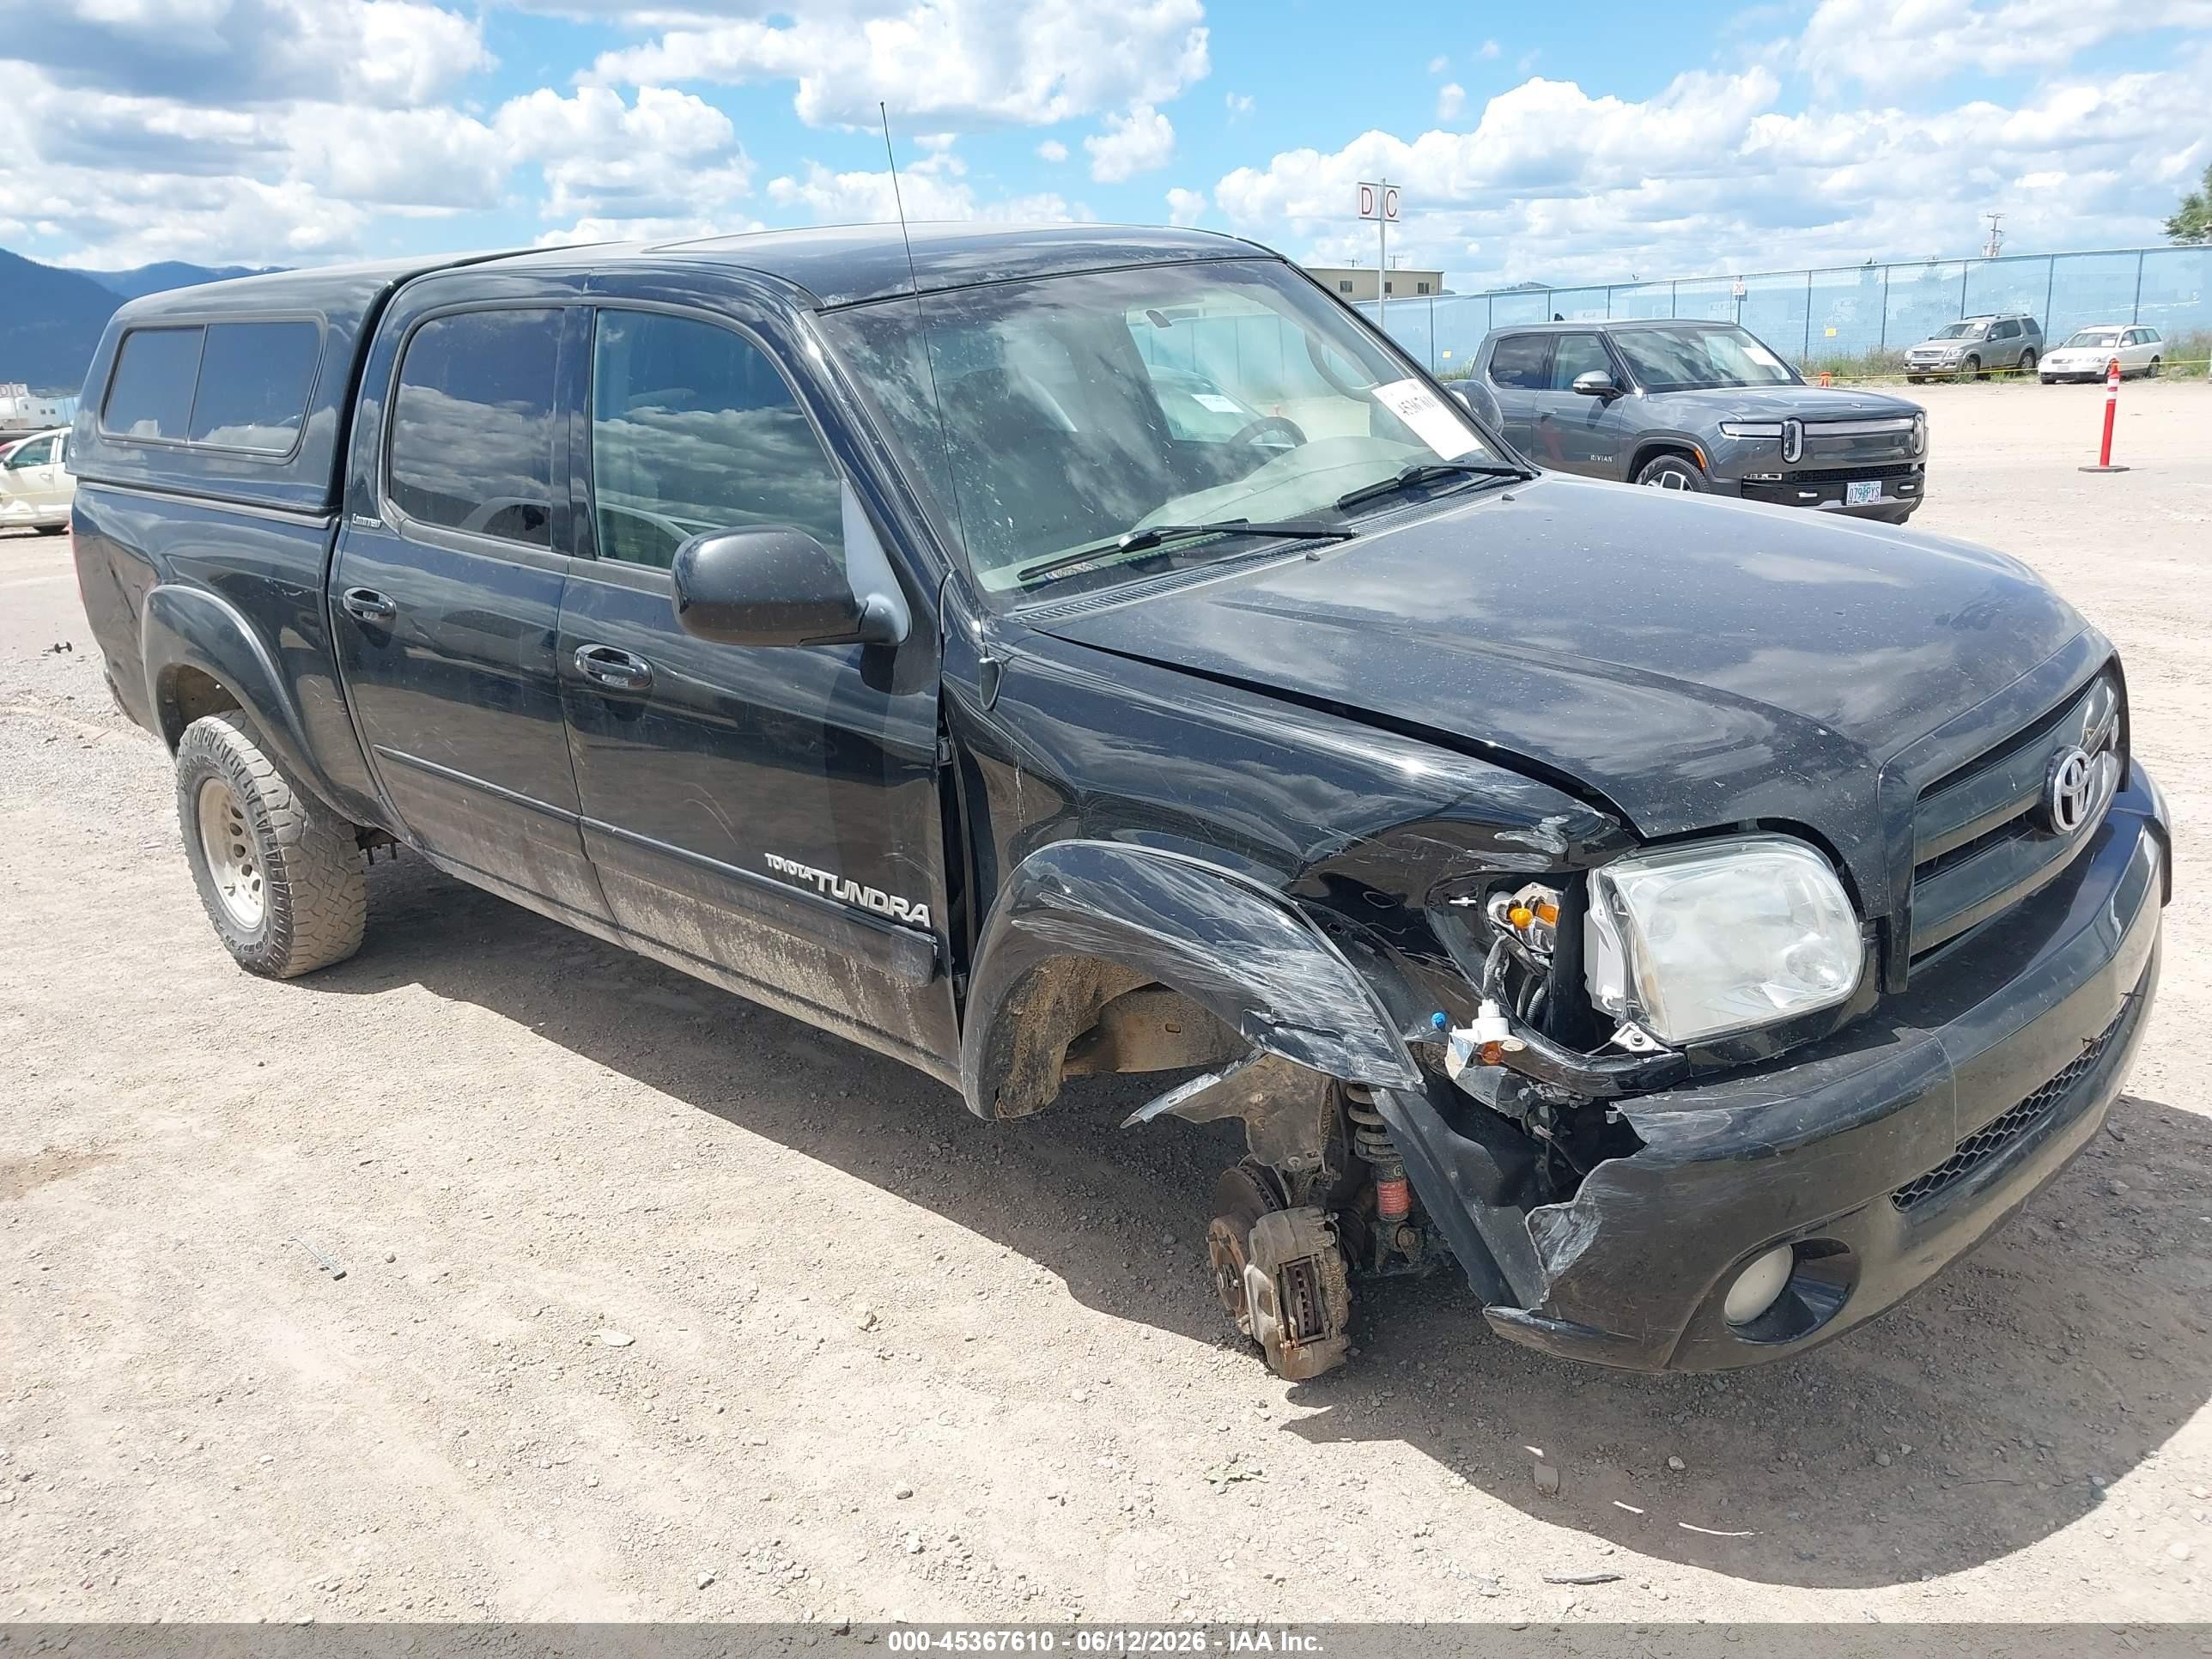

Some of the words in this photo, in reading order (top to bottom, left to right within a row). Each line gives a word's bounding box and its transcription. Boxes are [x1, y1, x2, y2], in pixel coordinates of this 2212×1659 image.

[1361, 186, 1373, 215] D
[1386, 189, 1398, 218] C
[1734, 283, 1745, 294] 20
[1589, 454, 1613, 464] RIVIAN
[764, 852, 814, 882] TOYOTA
[809, 867, 932, 928] TUNDRA
